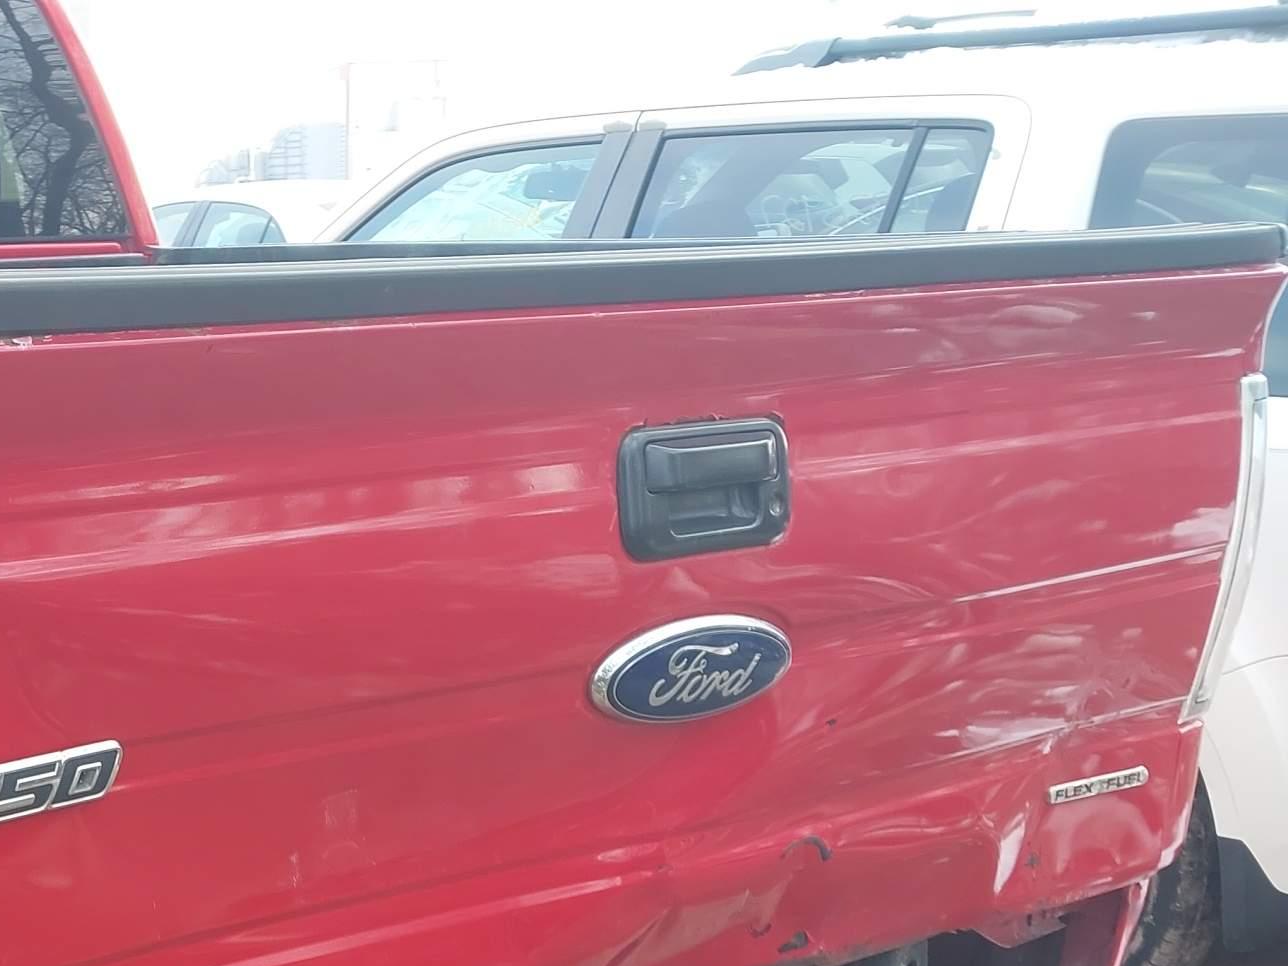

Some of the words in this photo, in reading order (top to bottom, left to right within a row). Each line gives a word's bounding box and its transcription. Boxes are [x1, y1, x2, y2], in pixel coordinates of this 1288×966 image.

[649, 643, 762, 707] Ford
[1054, 782, 1095, 802] FLEX
[1106, 771, 1144, 790] FUEL
